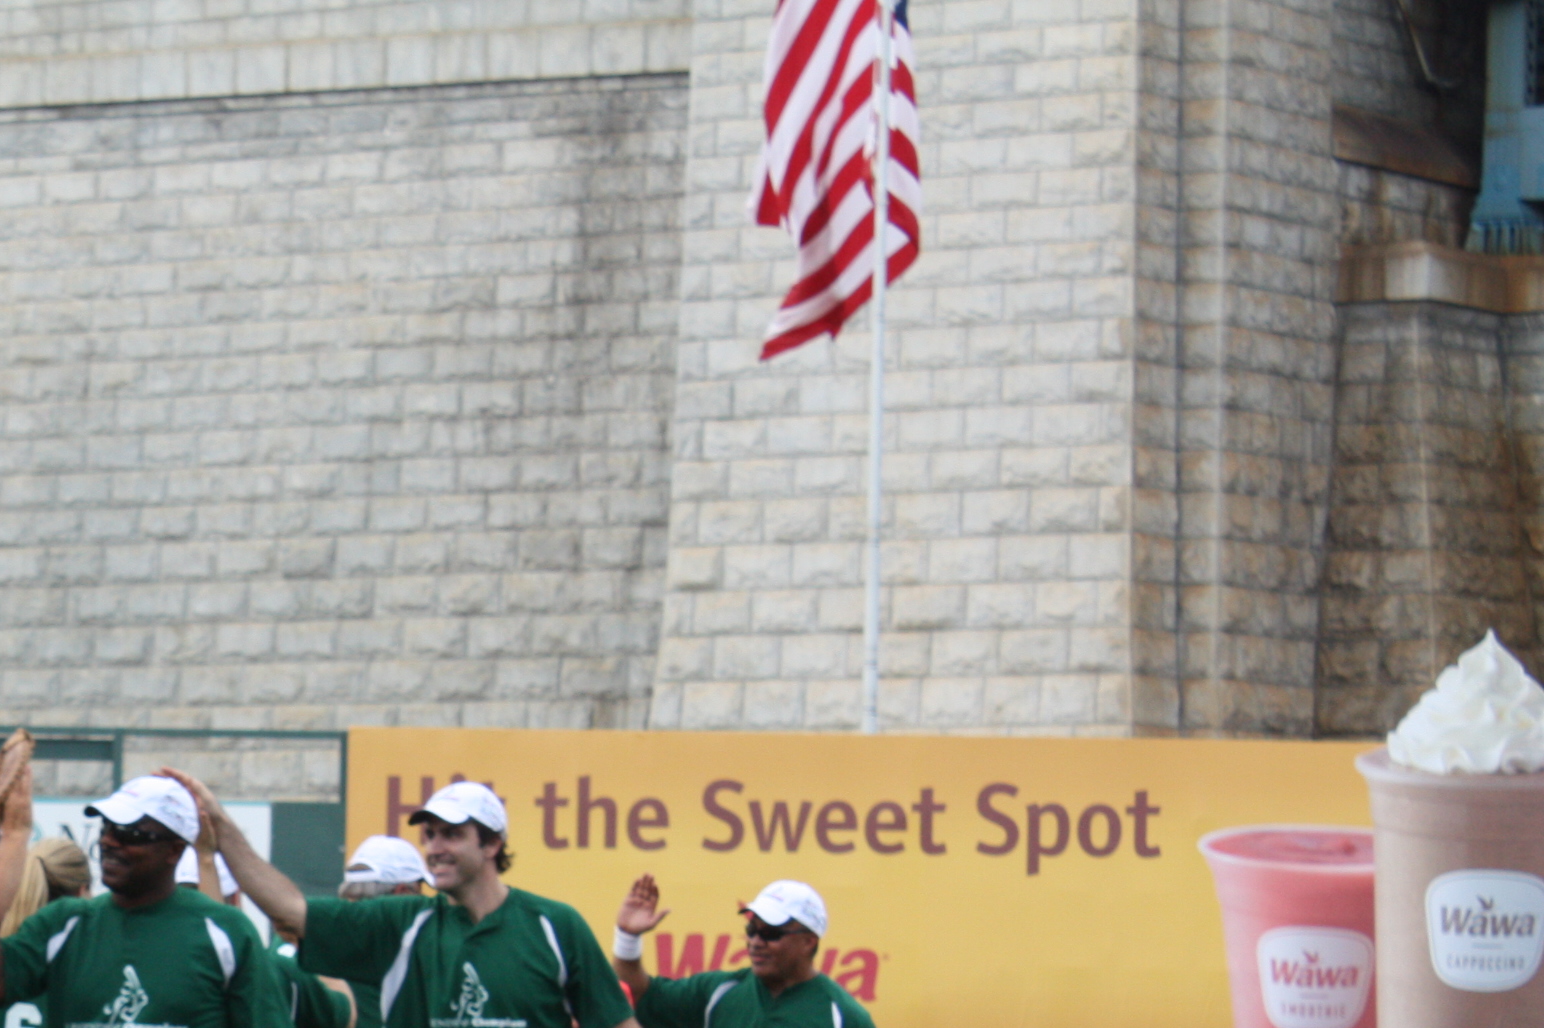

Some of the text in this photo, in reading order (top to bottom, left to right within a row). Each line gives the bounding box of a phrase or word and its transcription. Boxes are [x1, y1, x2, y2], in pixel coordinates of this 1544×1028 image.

[535, 776, 669, 850] the
[702, 779, 946, 856] Sweet
[976, 782, 1161, 877] Spot
[1440, 904, 1536, 938] Wawa
[655, 932, 882, 1001] Wa
[1269, 956, 1360, 989] Wawa
